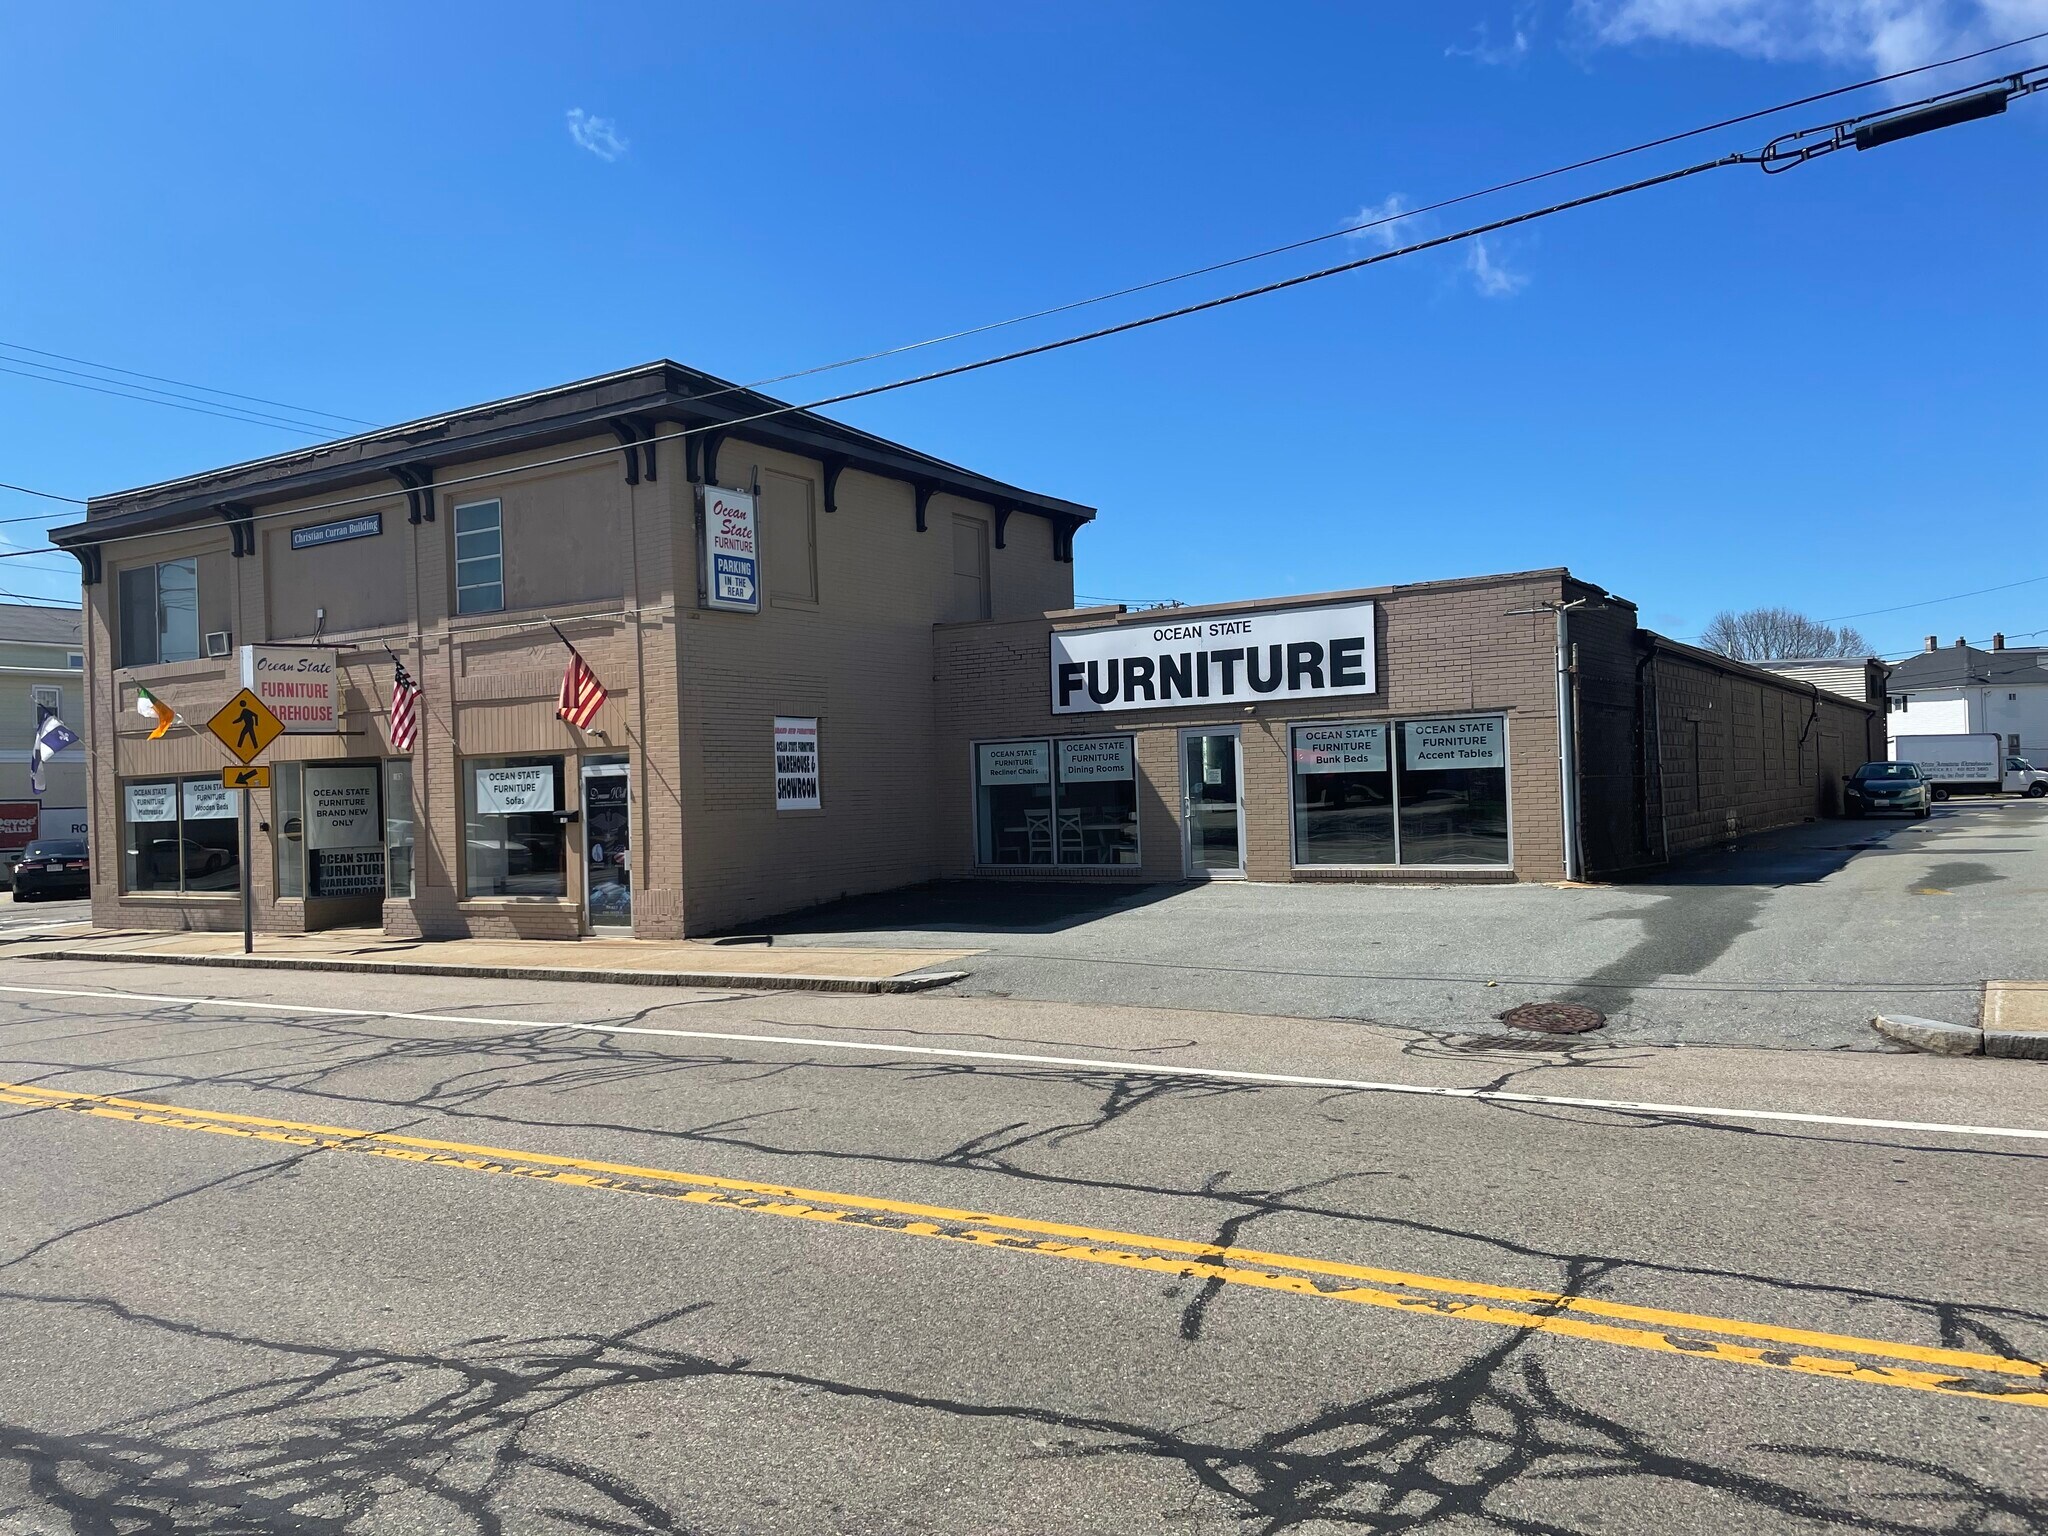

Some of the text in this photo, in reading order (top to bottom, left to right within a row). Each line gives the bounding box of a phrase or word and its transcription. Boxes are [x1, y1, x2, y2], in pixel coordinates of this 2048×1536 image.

[713, 500, 747, 520] Ocean
[294, 520, 378, 544] Christian Curran Building
[721, 519, 753, 539] State
[714, 536, 753, 553] FURNITURE
[718, 558, 751, 576] PARKING
[724, 576, 747, 588] IN THE
[727, 586, 744, 597] REAR
[1153, 620, 1252, 641] OCEAN STATE
[257, 657, 331, 673] Ocean State
[1058, 636, 1366, 707] FURNITURE
[261, 682, 328, 699] FURNITURE
[267, 705, 332, 721] AREHOUSE
[1305, 729, 1378, 740] OCEAN STATE
[1415, 723, 1494, 735] OCEAN STATE
[1066, 742, 1125, 752] OCEAN STATE
[1312, 742, 1372, 752] FURNITURE
[1422, 736, 1487, 747] FURNITURE
[990, 750, 1016, 758] OCEAN
[1071, 753, 1120, 762] FURNITURE
[1316, 754, 1369, 764] Bunk Beds
[1418, 749, 1493, 760] Accent Tables
[776, 755, 810, 773] WAREHOUSE
[1068, 764, 1125, 774] Dining Rooms
[489, 770, 540, 781] OCEAN STATE
[990, 767, 1039, 776] Recliner Chairs
[134, 788, 152, 796] OCEAN
[193, 783, 224, 792] OCEAN STA
[313, 788, 370, 797] OCEAN STATE
[494, 783, 536, 793] FURNITURE
[778, 777, 817, 799] SHOWROOM
[137, 798, 165, 806] FURNITURE
[196, 793, 226, 801] FURNITURE
[505, 796, 525, 805] Sofas
[195, 803, 216, 811] Wooden
[318, 799, 365, 807] FURNITURE
[316, 808, 369, 817] BRAND NEW
[332, 819, 354, 827] ONLY
[320, 853, 354, 864] OCEAN
